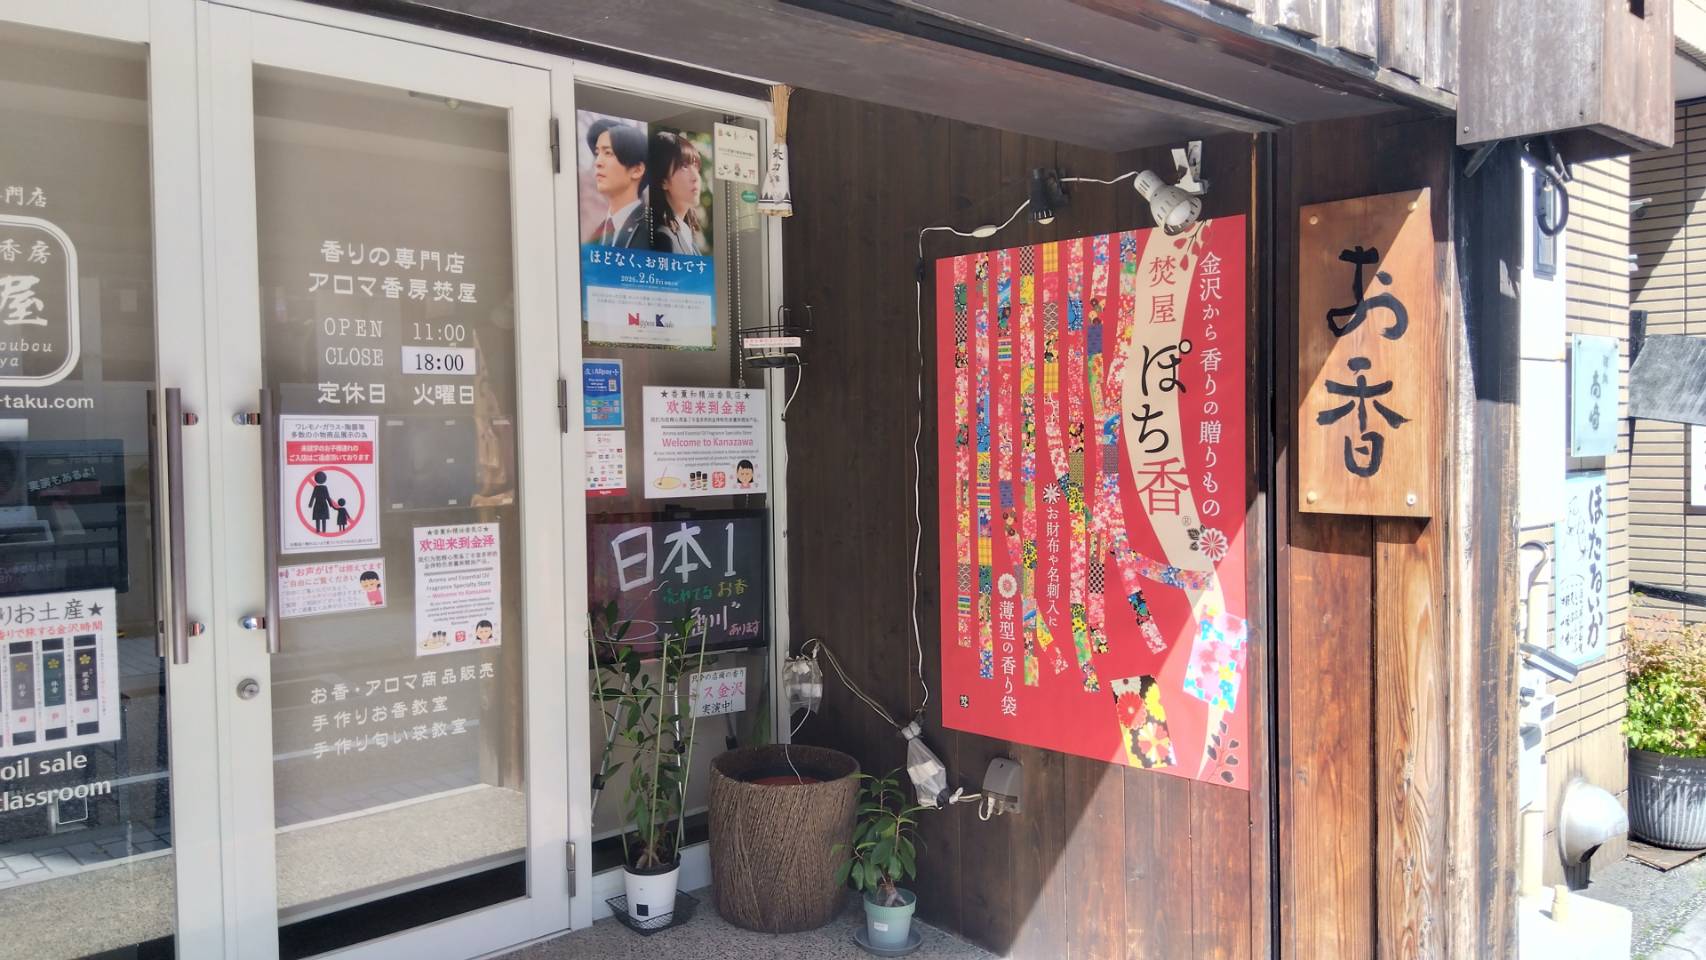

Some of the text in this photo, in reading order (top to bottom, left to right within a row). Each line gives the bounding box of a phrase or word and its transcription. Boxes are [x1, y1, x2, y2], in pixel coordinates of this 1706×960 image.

[0, 186, 47, 208] 門店
[320, 240, 465, 274] 香りの専門店
[590, 250, 707, 274] ほどなく、お別れです
[308, 272, 478, 303] アロマ香房焚屋
[324, 317, 466, 342] OPEN 11:00
[325, 346, 465, 372] CLOSE 18:00
[1317, 246, 1413, 478] お香
[317, 381, 475, 406] 定休日 火曜日
[1131, 256, 1193, 517] 焚屋 ぽち香
[1199, 251, 1224, 518] 金沢から香りの贈りもの
[662, 437, 753, 447] Welcome to Kanazawa
[0, 596, 84, 625] りお土産
[999, 601, 1017, 717] 薄型の香り袋
[311, 662, 495, 704] お香・アロマ商品販売
[311, 695, 448, 732] 手作りお香教室
[313, 717, 467, 759] 手作り匂い袋教室
[0, 751, 88, 780] oil sale
